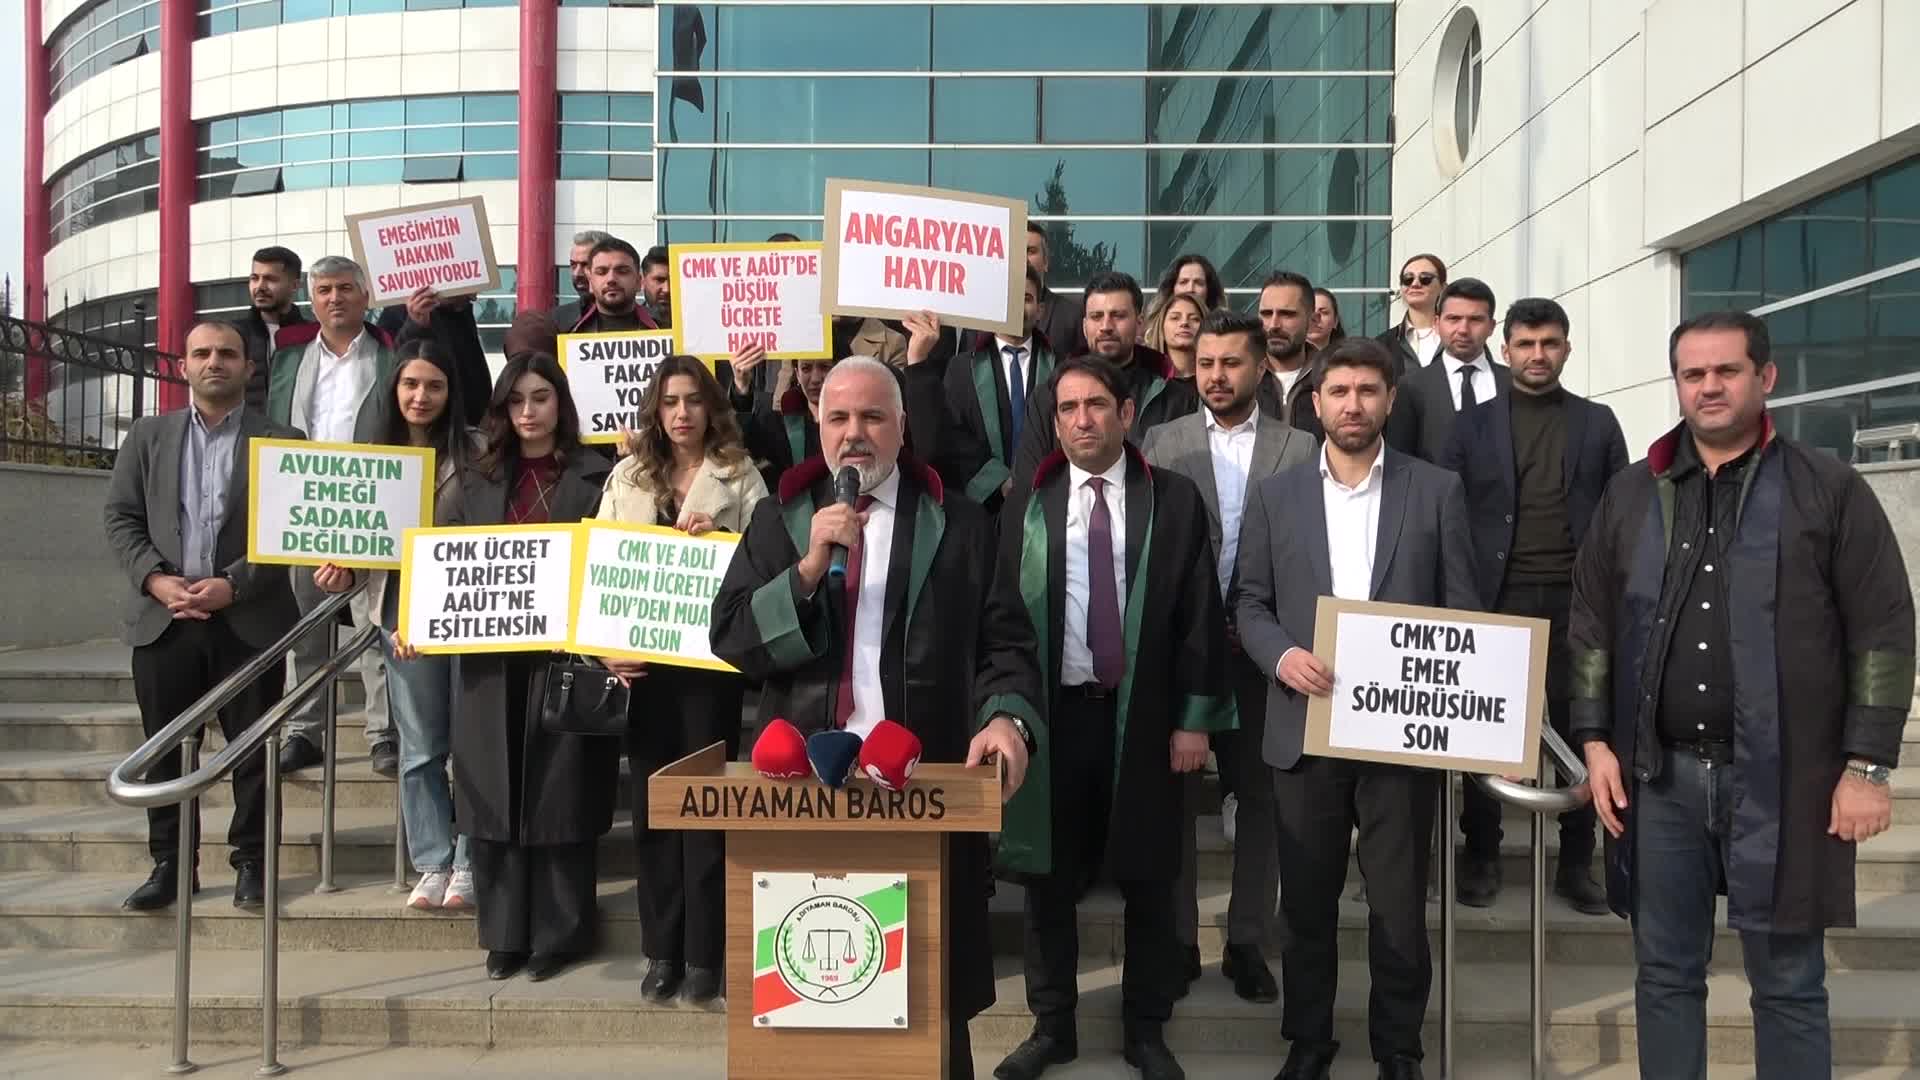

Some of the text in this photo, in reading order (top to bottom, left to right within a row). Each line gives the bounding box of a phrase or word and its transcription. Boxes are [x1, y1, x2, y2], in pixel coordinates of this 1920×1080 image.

[377, 215, 461, 247] EMEĞİMİZİN
[844, 212, 1005, 259] ANGARYAYA
[394, 241, 455, 267] HAKKINI
[682, 257, 717, 278] CMK
[720, 257, 742, 278] VE
[378, 260, 481, 293] SAVUNUYORUZ
[884, 255, 966, 296] HAYIR
[722, 278, 779, 305] DÜŞÜK
[721, 304, 782, 328] ÜCRETE
[615, 387, 647, 407] YO
[279, 453, 402, 480] AVUKATIN
[303, 479, 377, 504] EMEĞİ
[289, 505, 388, 530] SADAKA
[282, 529, 394, 556] DEĞİLDİR
[433, 536, 551, 562] CMK ÜCRET
[617, 539, 717, 570] CMK VE ADLİ
[445, 561, 536, 587] TARİFESİ
[590, 563, 650, 592] YARDIM
[442, 588, 535, 612] AAÜT'NE
[599, 593, 671, 623] KDV'DEN
[428, 612, 547, 642] EŞİTLENSİN
[628, 625, 682, 652] OLSUN
[1390, 622, 1476, 654] CMK'DA
[1401, 656, 1461, 686] EMEK
[1352, 681, 1507, 723] SÖMÜRÜSÜNE
[1403, 723, 1449, 752] SON
[680, 785, 946, 819] ADIYAMAN BAROS
